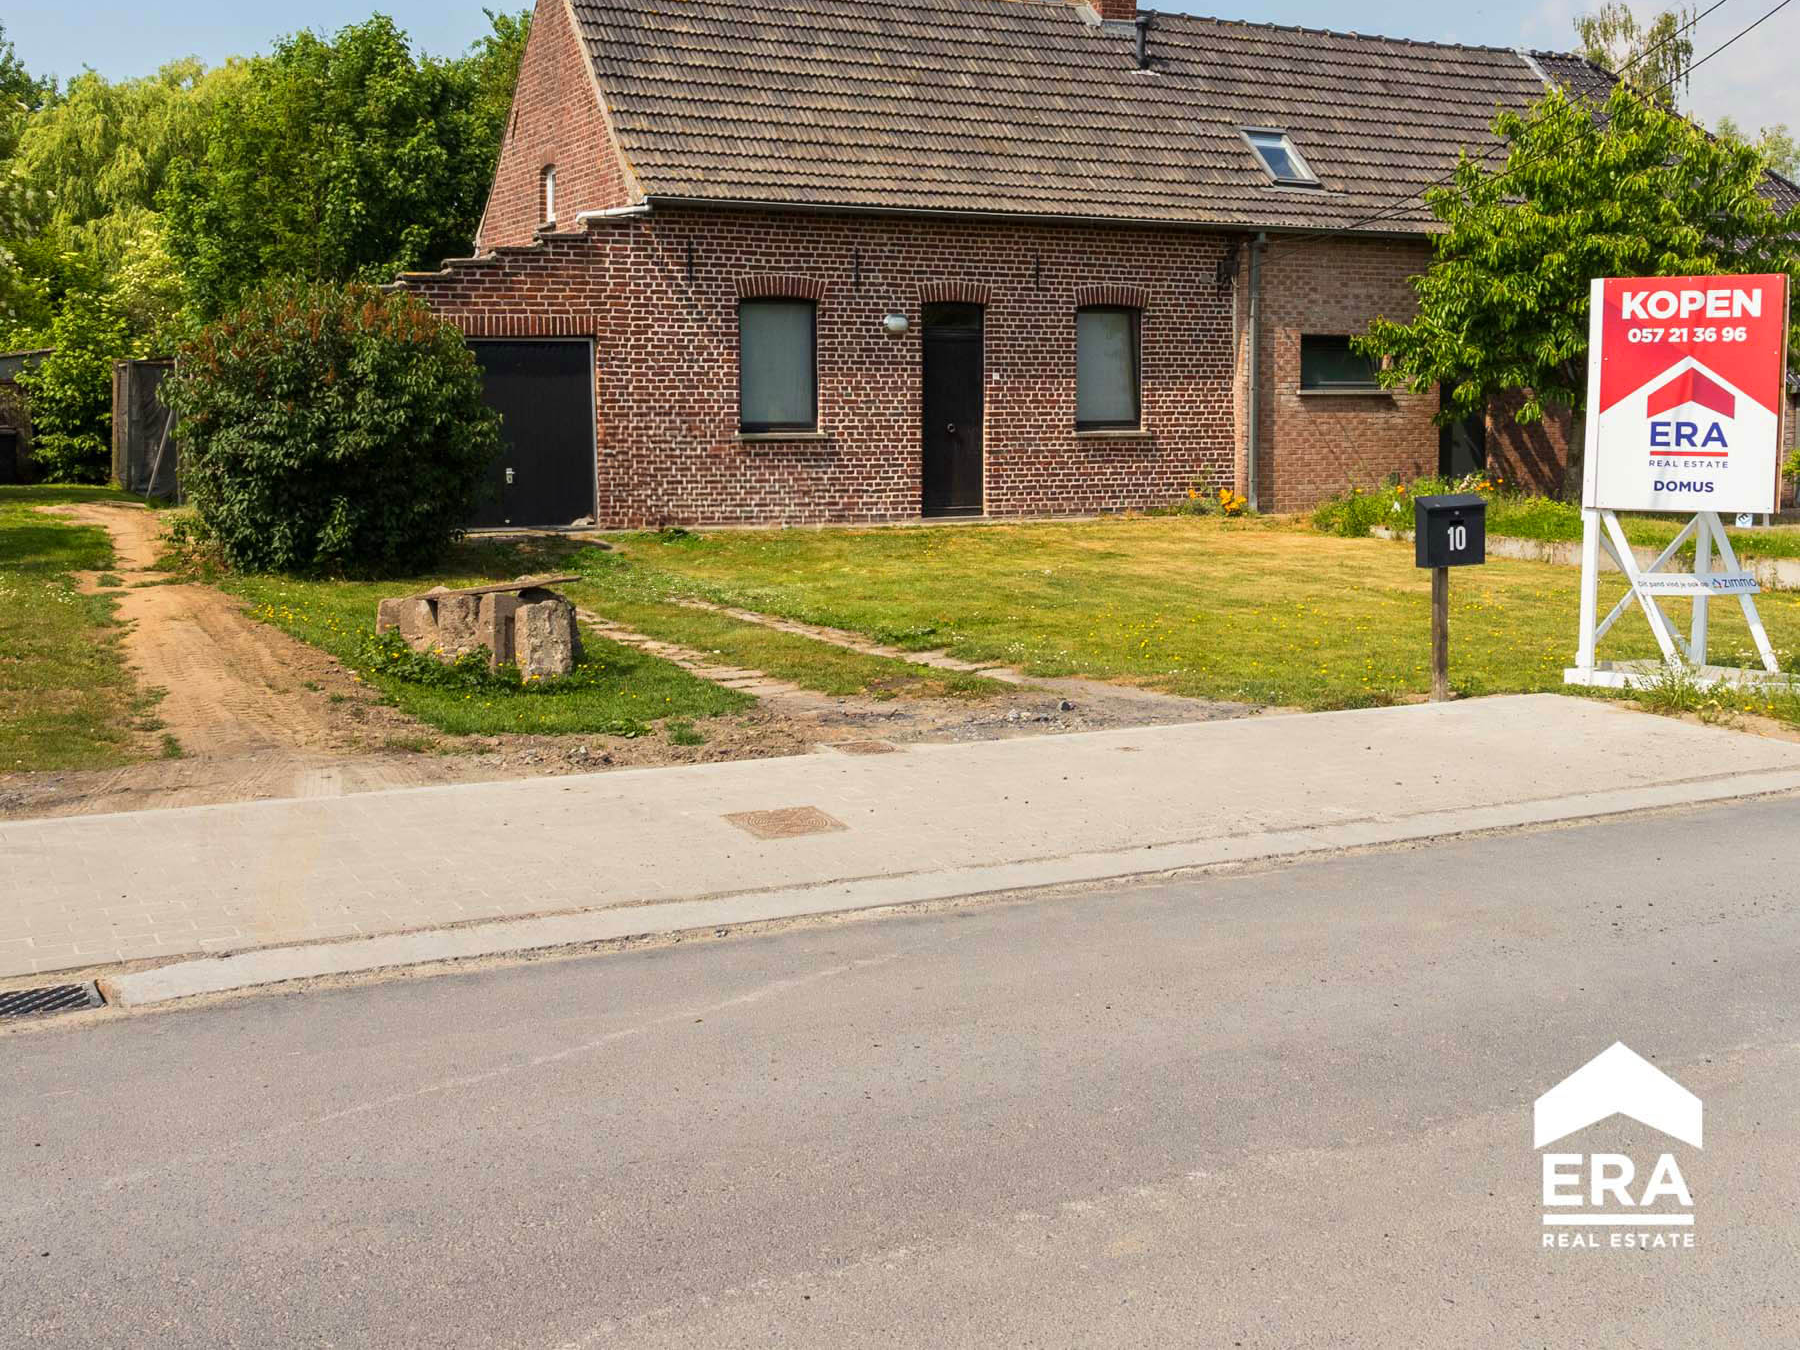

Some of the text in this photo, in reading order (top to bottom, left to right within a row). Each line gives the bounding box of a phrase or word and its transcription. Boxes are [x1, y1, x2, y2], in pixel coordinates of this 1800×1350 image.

[1621, 288, 1762, 320] KOPEN
[1627, 327, 1748, 343] 057 21 36 96
[1649, 421, 1729, 448] ERA
[1648, 459, 1729, 469] REAL ESTATE
[1653, 480, 1715, 493] DOMUS
[1447, 525, 1466, 551] 10
